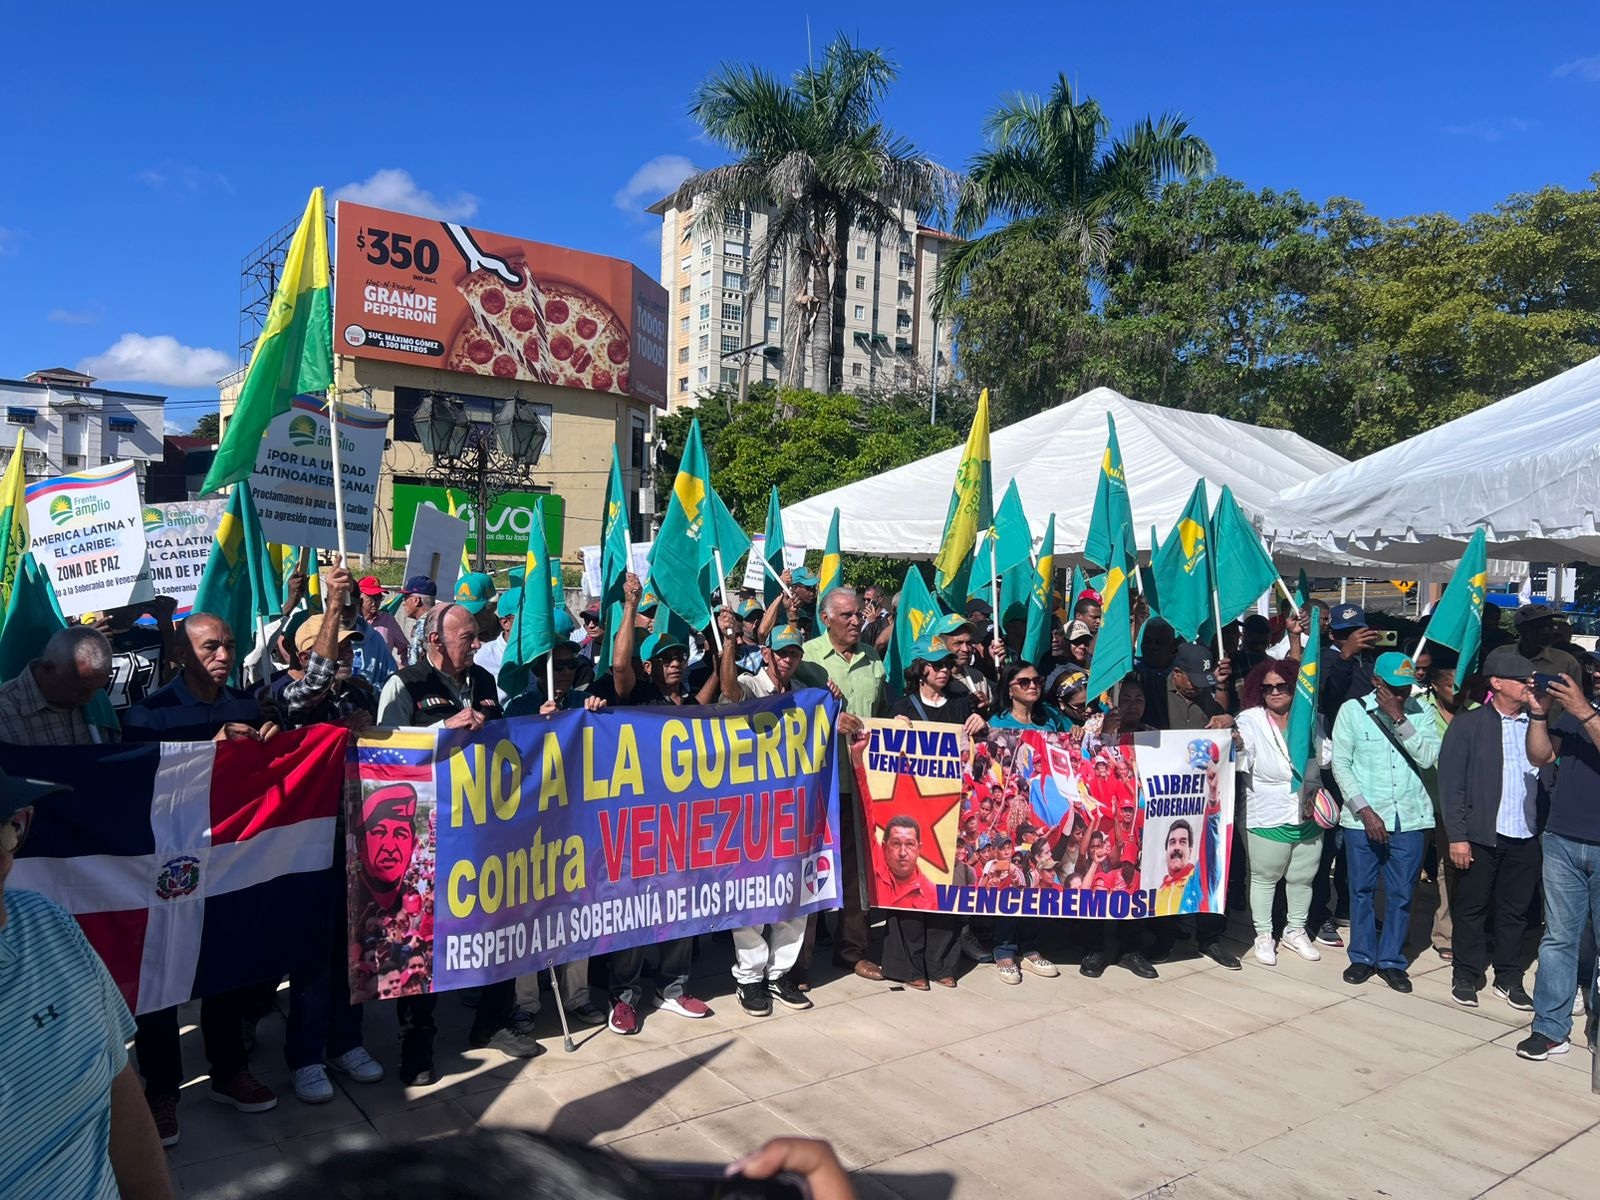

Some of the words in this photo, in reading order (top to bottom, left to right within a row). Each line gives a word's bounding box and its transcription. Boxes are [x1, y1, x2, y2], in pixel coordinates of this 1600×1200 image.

[356, 226, 440, 275] $350
[364, 286, 437, 312] GRANDE
[364, 301, 437, 325] PEPPERONI
[637, 305, 665, 342] TODOS!
[384, 333, 414, 345] MÁXIMO
[415, 338, 438, 349] GÓMEZ
[400, 343, 428, 354] METROS
[637, 332, 665, 368] TODOS!
[267, 449, 298, 464] ¡POR
[301, 455, 317, 468] LA
[74, 494, 97, 506] Frente
[75, 499, 111, 517] amplio
[253, 488, 304, 505] Proclamamos
[305, 496, 312, 506] la
[313, 499, 326, 509] paz
[167, 515, 205, 527] amplio
[258, 508, 263, 517] a
[265, 508, 272, 518] la
[274, 510, 307, 524] agresión
[308, 515, 332, 528] contra
[31, 528, 81, 548] AMERICA
[83, 520, 125, 537] LATINA
[127, 517, 136, 527] Y
[176, 536, 212, 547] LATIN
[54, 548, 68, 558] EL
[70, 538, 116, 555] CARIBE:
[160, 549, 211, 560] CARIBE:
[57, 564, 83, 582] ZONA
[86, 561, 98, 576] DE
[100, 555, 120, 573] PAZ
[175, 565, 190, 578] DE
[68, 587, 74, 595] la
[105, 579, 114, 587] de
[869, 728, 960, 758] ¡VIVA
[449, 743, 521, 828] NO
[538, 731, 569, 812] A
[583, 723, 644, 801] LA
[660, 703, 832, 793] GUERRA
[869, 753, 961, 780] VENEZUELA!
[1147, 774, 1205, 797] ¡LIBRE!
[1146, 797, 1205, 819] ¡SOBERANA!
[447, 826, 587, 918] contra
[598, 785, 833, 883] VENEZUELA
[937, 884, 1157, 918] VENCEREMOS!
[445, 928, 526, 971] RESPETO
[531, 923, 542, 953] A
[546, 919, 566, 950] LA
[571, 885, 662, 944] SOBERANÍA
[666, 889, 688, 920] DE
[692, 884, 721, 918] LOS
[725, 872, 794, 909] PUEBLOS
